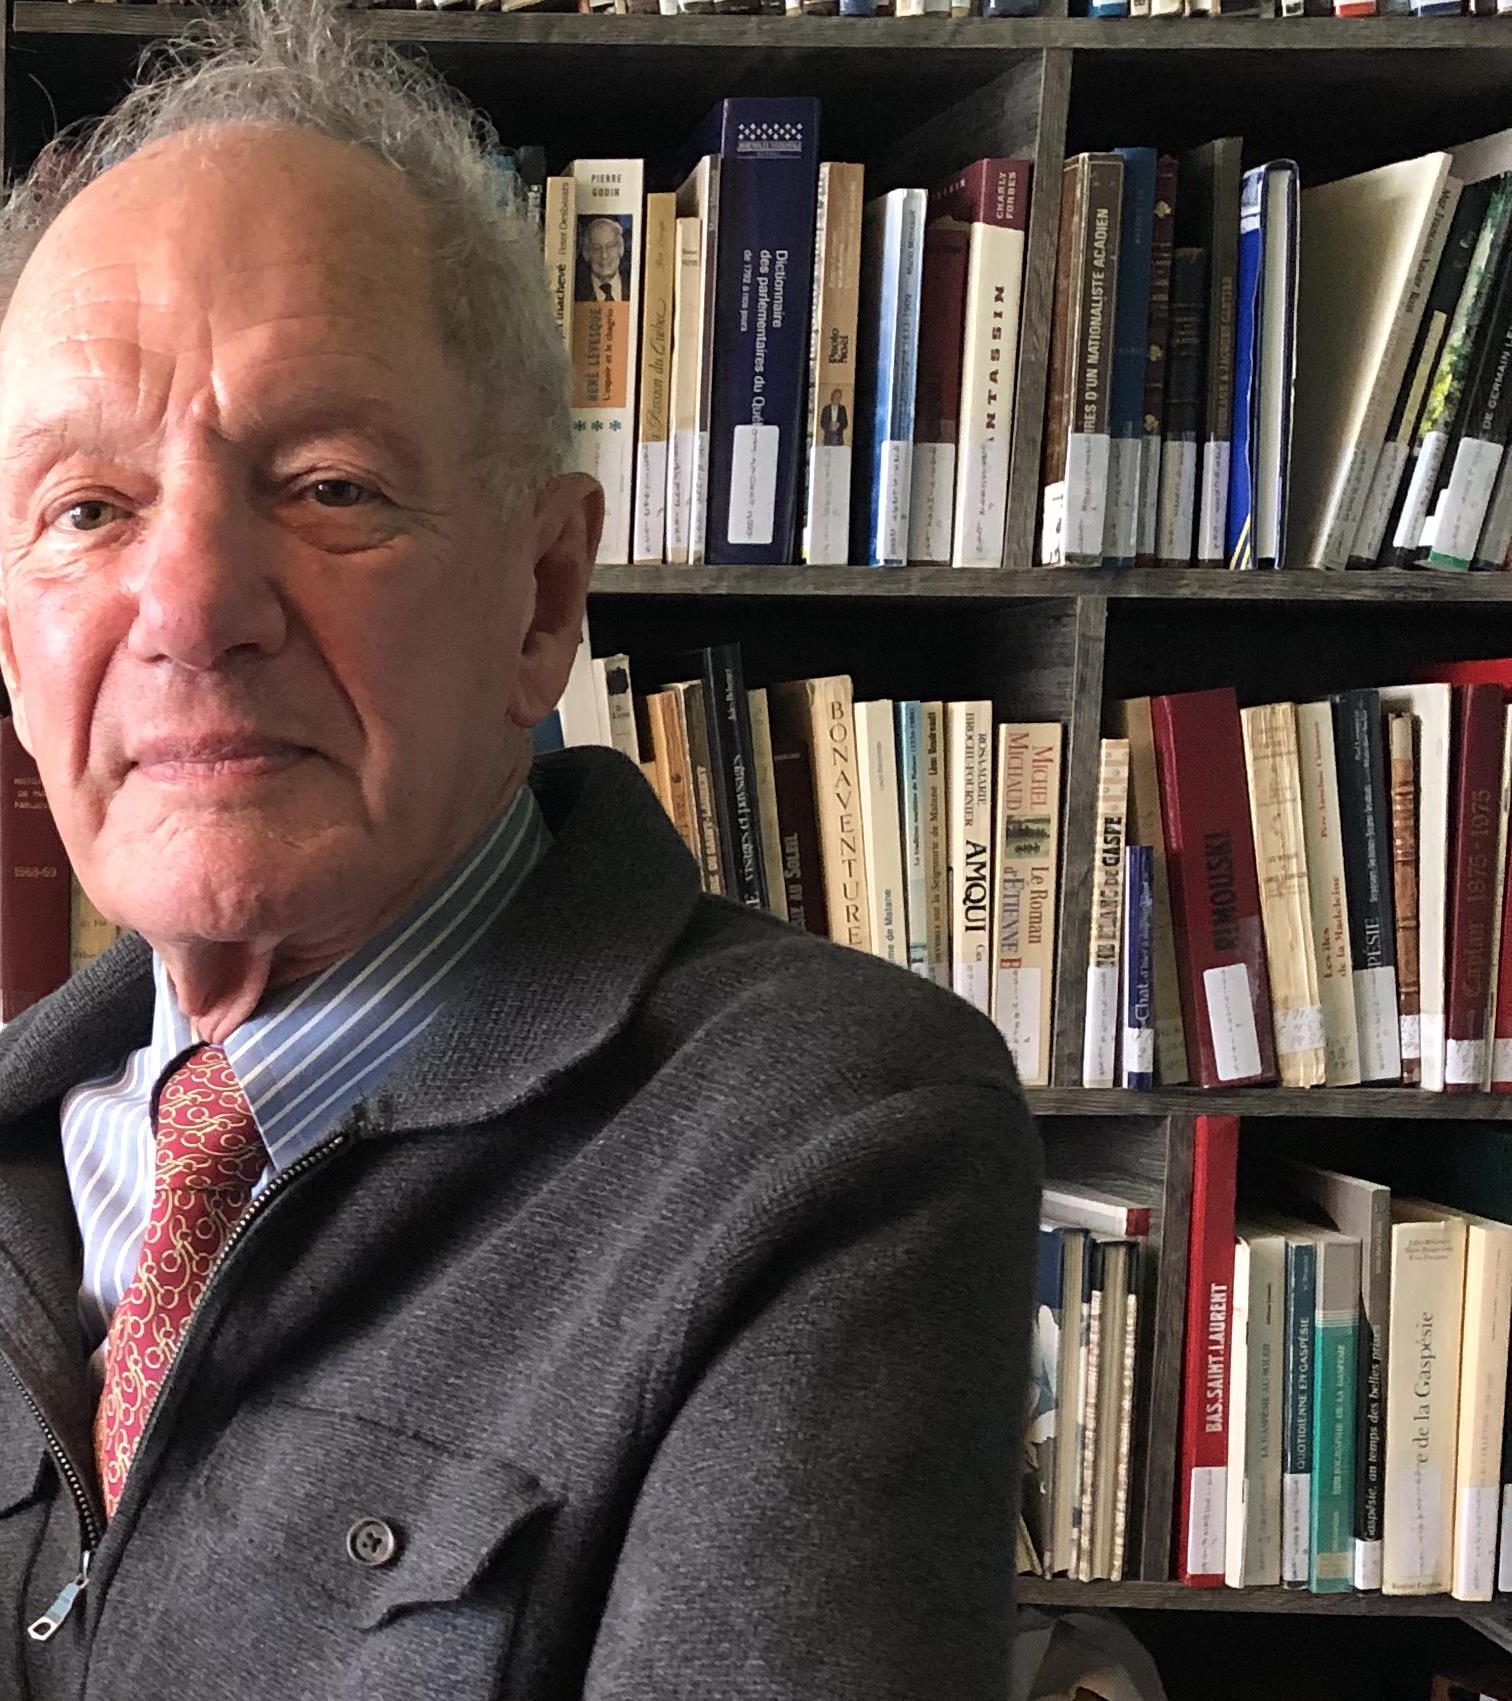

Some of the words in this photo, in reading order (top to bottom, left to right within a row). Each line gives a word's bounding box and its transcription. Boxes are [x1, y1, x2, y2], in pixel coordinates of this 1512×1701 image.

[591, 173, 622, 184] PIERRE
[592, 187, 620, 198] GODIN
[995, 171, 1007, 219] CHARLY
[1005, 171, 1017, 220] FORBES
[1095, 208, 1109, 268] ACADIEN
[759, 250, 772, 274] des
[773, 249, 788, 328] Dictionnaire
[754, 276, 770, 374] parlementaires
[1088, 271, 1106, 364] NATIONALISTE
[754, 375, 766, 393] du
[1086, 368, 1100, 401] D'UN
[1488, 351, 1511, 409] GERMAIN
[1482, 412, 1495, 430] DE
[1006, 732, 1030, 811] MICHAUD
[829, 701, 863, 946] BONAVENTURE
[962, 840, 987, 933] AMQUI
[1031, 866, 1050, 885] Le
[884, 888, 894, 926] Matane
[1028, 889, 1049, 945] Roman
[1298, 1317, 1310, 1371] GASPÉSIE
[1414, 1311, 1437, 1398] Gaspésie
[1298, 1372, 1308, 1390] EN
[1368, 1363, 1381, 1399] belles
[1298, 1393, 1309, 1470] QUOTIDIENNE
[1367, 1402, 1380, 1423] des
[1413, 1404, 1431, 1423] la
[1368, 1426, 1380, 1462] temps
[1412, 1430, 1429, 1449] de
[1368, 1465, 1377, 1482] au
